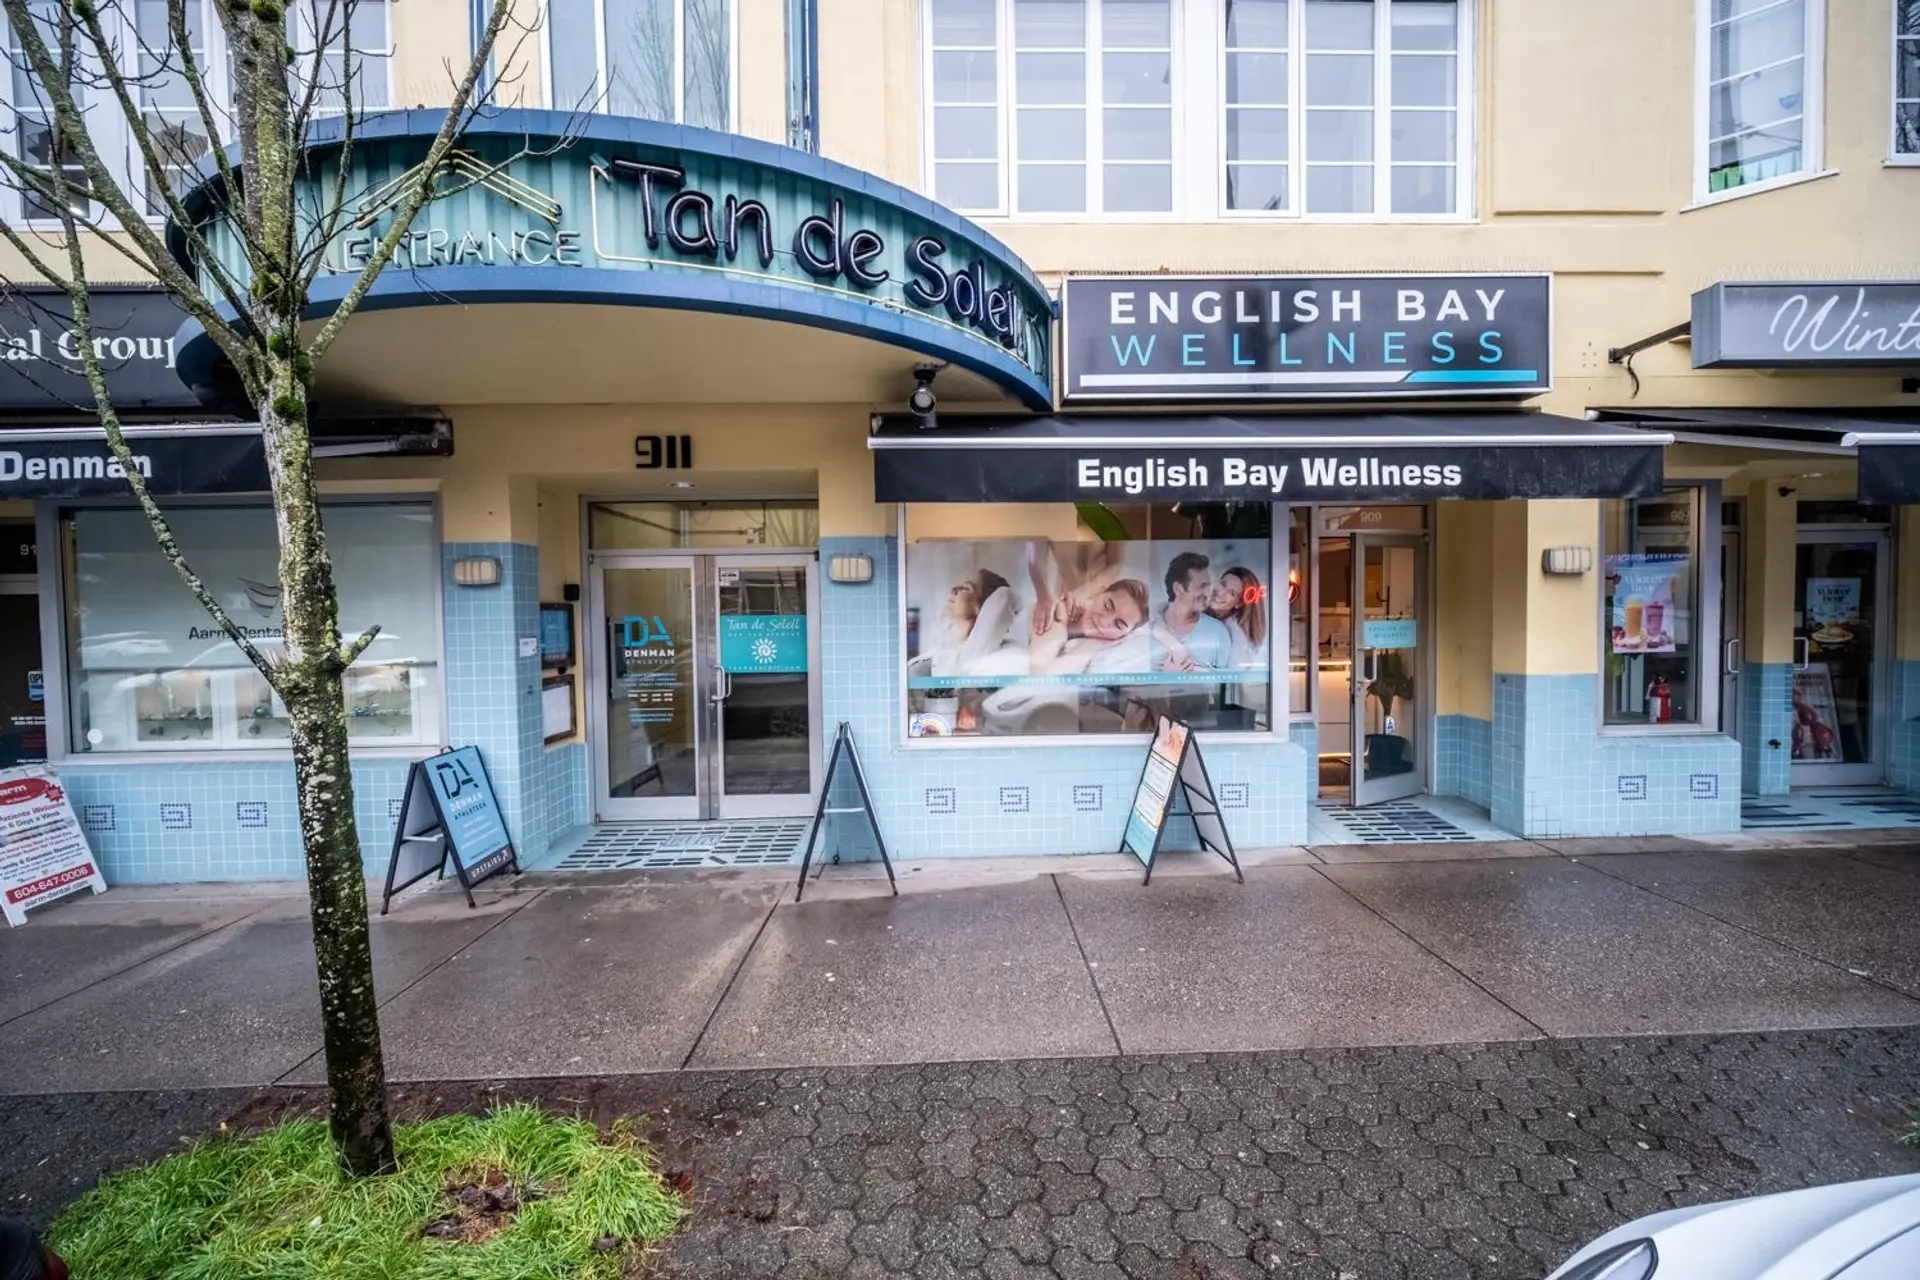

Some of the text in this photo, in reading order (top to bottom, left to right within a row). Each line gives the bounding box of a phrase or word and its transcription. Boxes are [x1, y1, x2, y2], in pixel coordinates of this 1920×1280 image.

[610, 155, 774, 268] Tan
[793, 198, 889, 288] de
[1110, 289, 1506, 324] ENGLISH BAY
[1110, 331, 1504, 367] WELLNESS
[0, 450, 152, 481] Denman
[635, 435, 692, 469] 911
[1077, 457, 1463, 493] English Bay Wellness
[1360, 511, 1382, 523] 909
[728, 618, 748, 631] Tan
[751, 617, 765, 630] de
[624, 649, 675, 658] DENMAN
